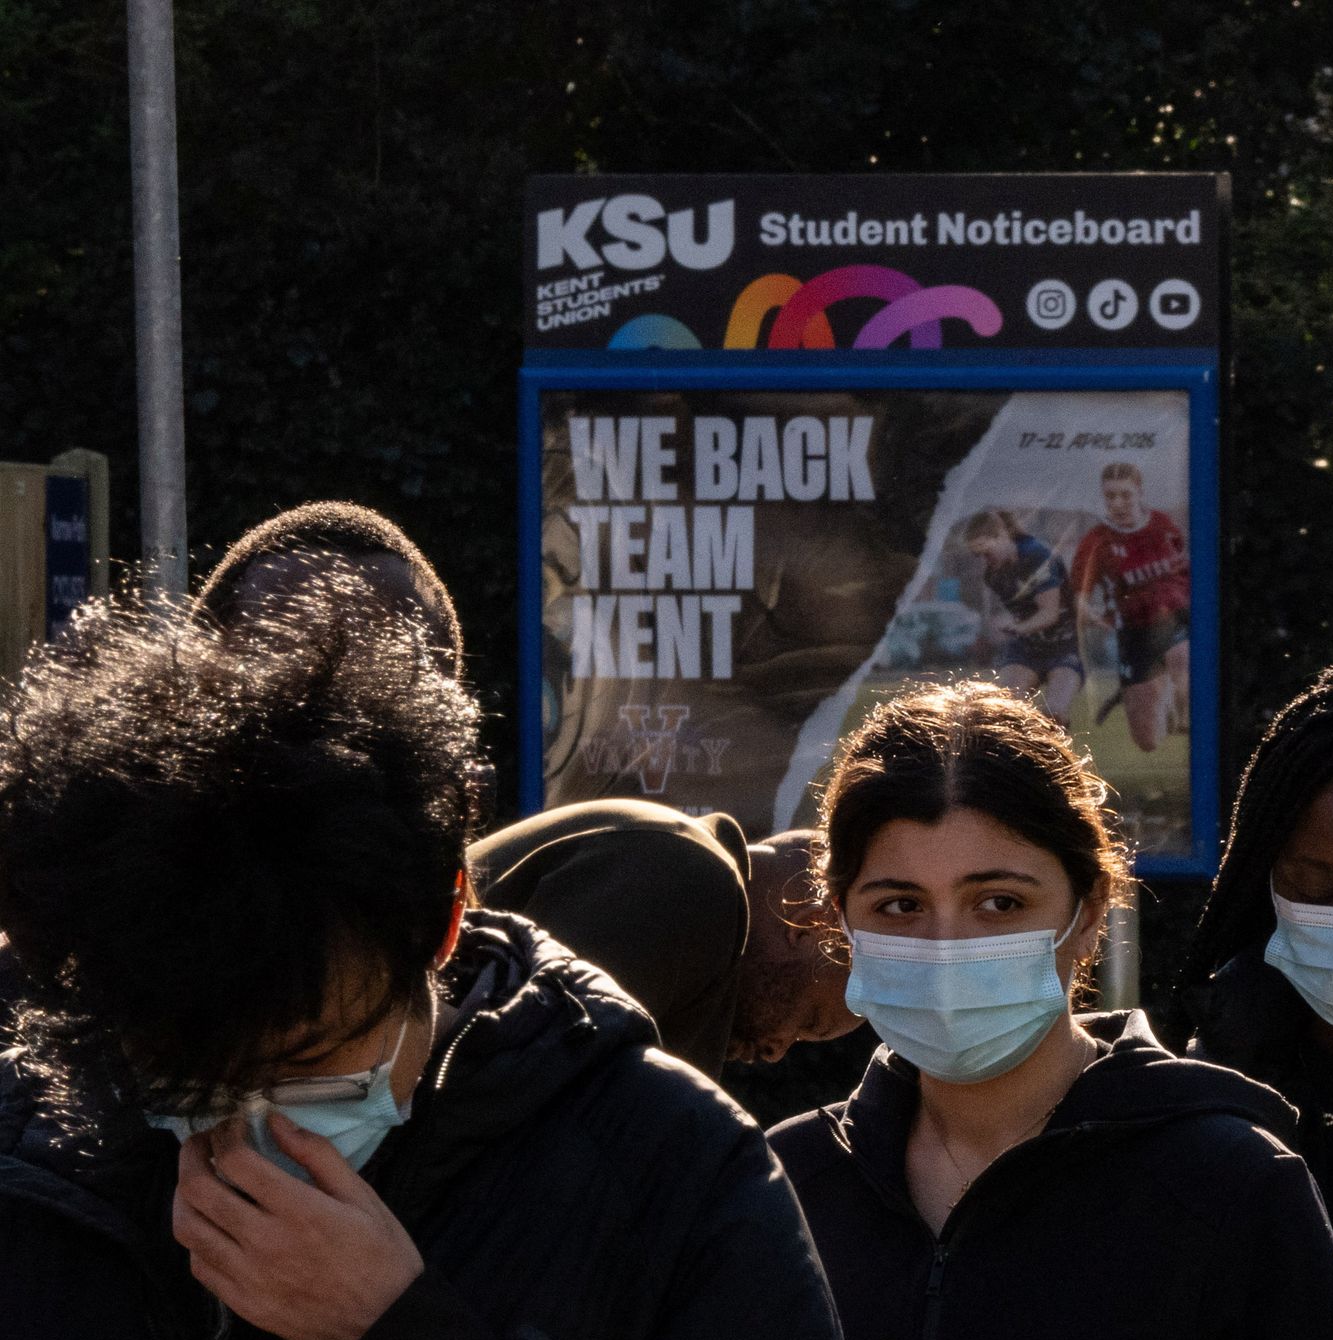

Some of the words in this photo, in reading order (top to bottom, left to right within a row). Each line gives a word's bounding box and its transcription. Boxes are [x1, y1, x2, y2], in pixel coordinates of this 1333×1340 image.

[537, 193, 735, 270] KSU
[759, 211, 928, 246] Student
[937, 209, 1201, 245] Noticeboard
[537, 272, 605, 300] KENT
[537, 303, 610, 332] UNION
[568, 416, 679, 501] WE
[695, 416, 876, 501] BACK
[570, 506, 755, 590] TEAM
[571, 595, 742, 679] KENT
